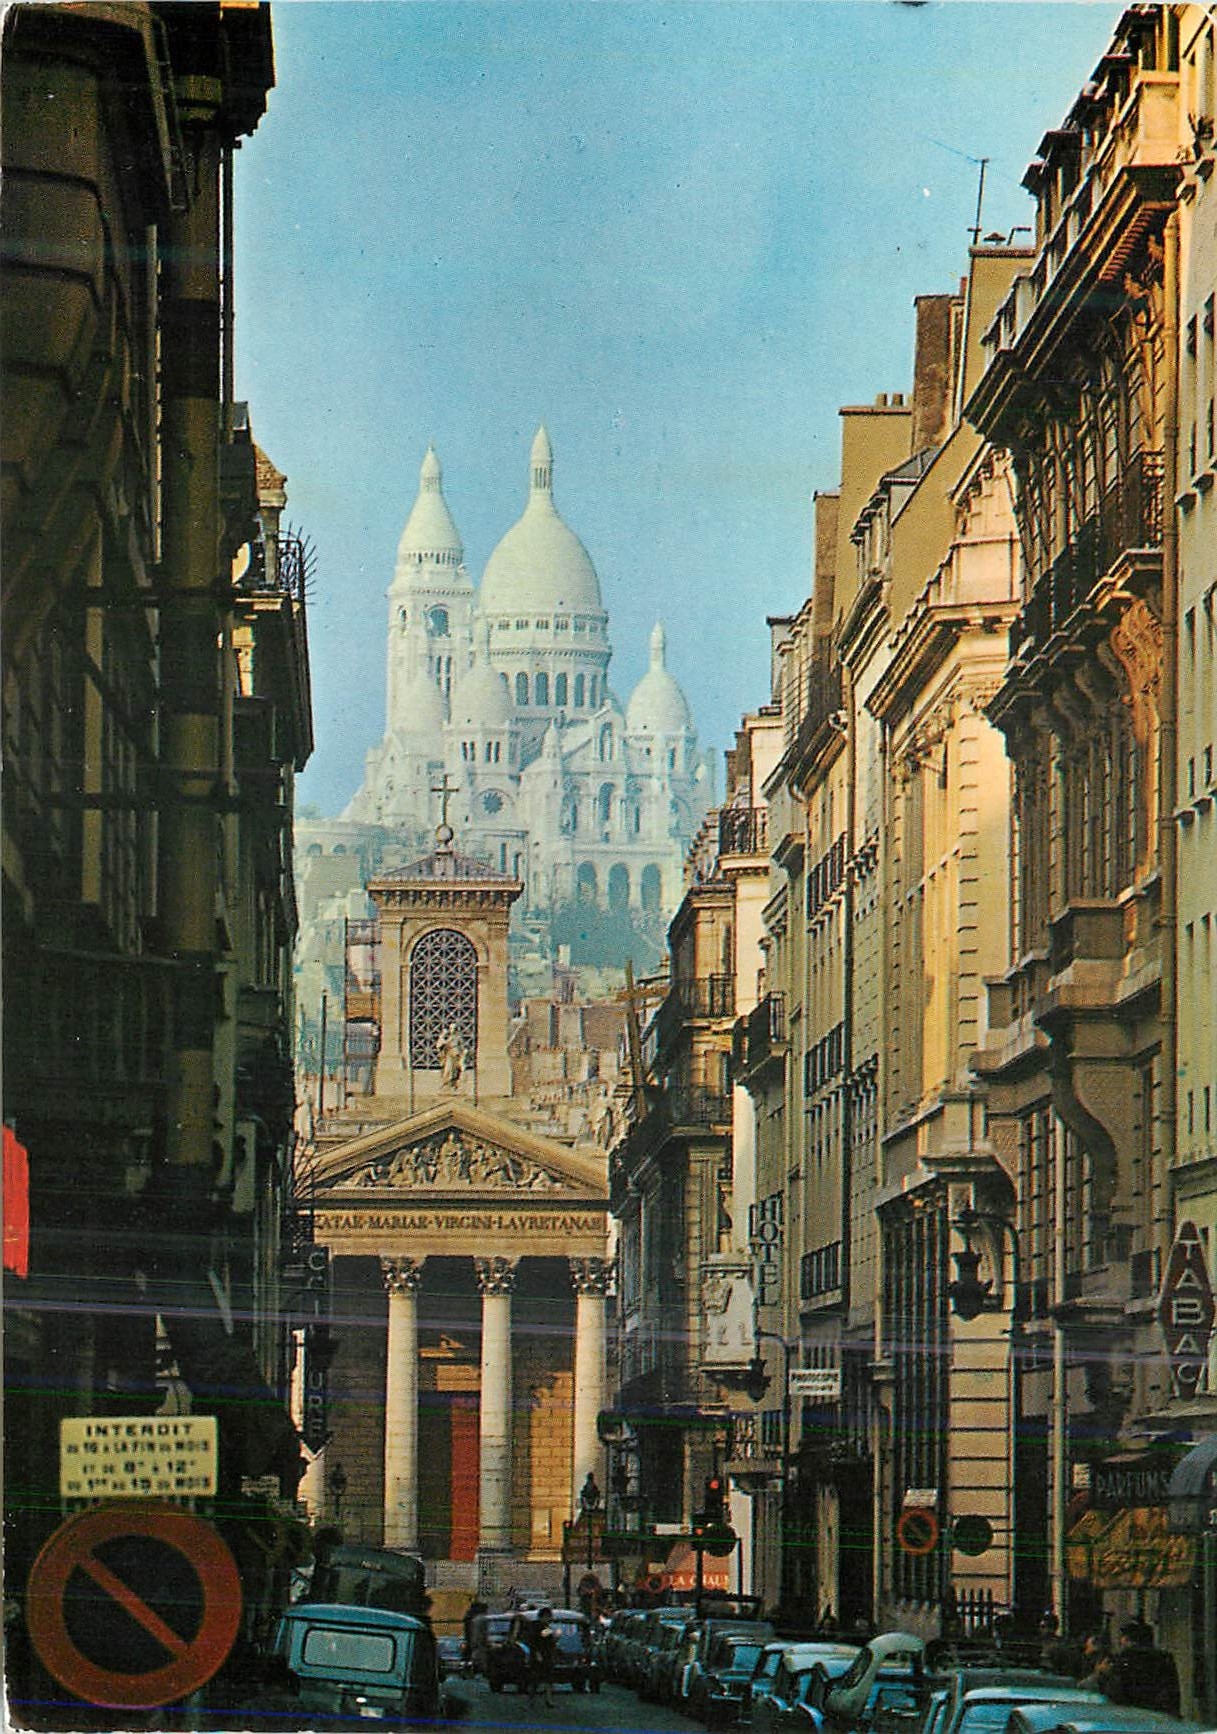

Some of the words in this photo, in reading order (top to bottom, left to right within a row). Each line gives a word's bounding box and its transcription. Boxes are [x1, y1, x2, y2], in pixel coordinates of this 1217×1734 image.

[759, 1200, 778, 1306] HOTEL
[1172, 1239, 1206, 1383] TABAC
[86, 1423, 193, 1437] INTERDIT
